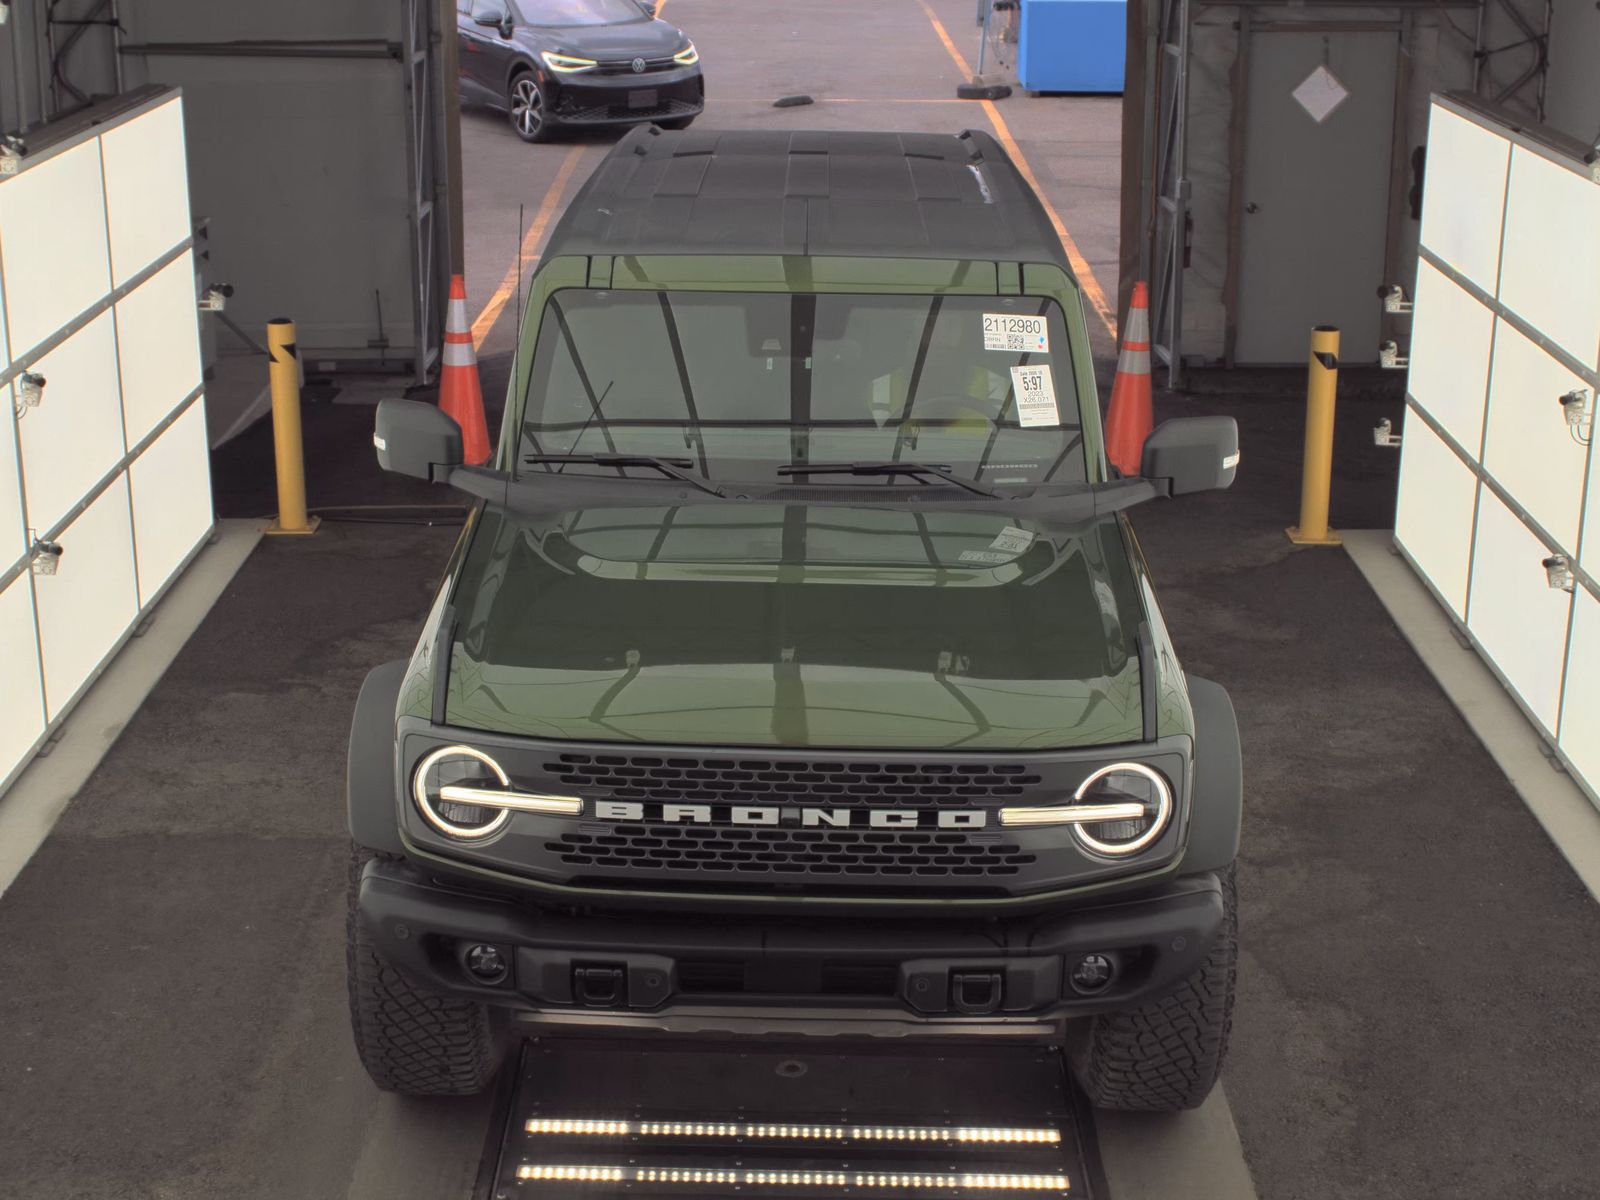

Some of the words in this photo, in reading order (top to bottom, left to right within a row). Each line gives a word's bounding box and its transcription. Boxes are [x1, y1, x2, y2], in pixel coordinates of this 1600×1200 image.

[984, 317, 1041, 334] 2112980
[1022, 376, 1042, 391] 5:97
[595, 800, 987, 828] BRONCO
